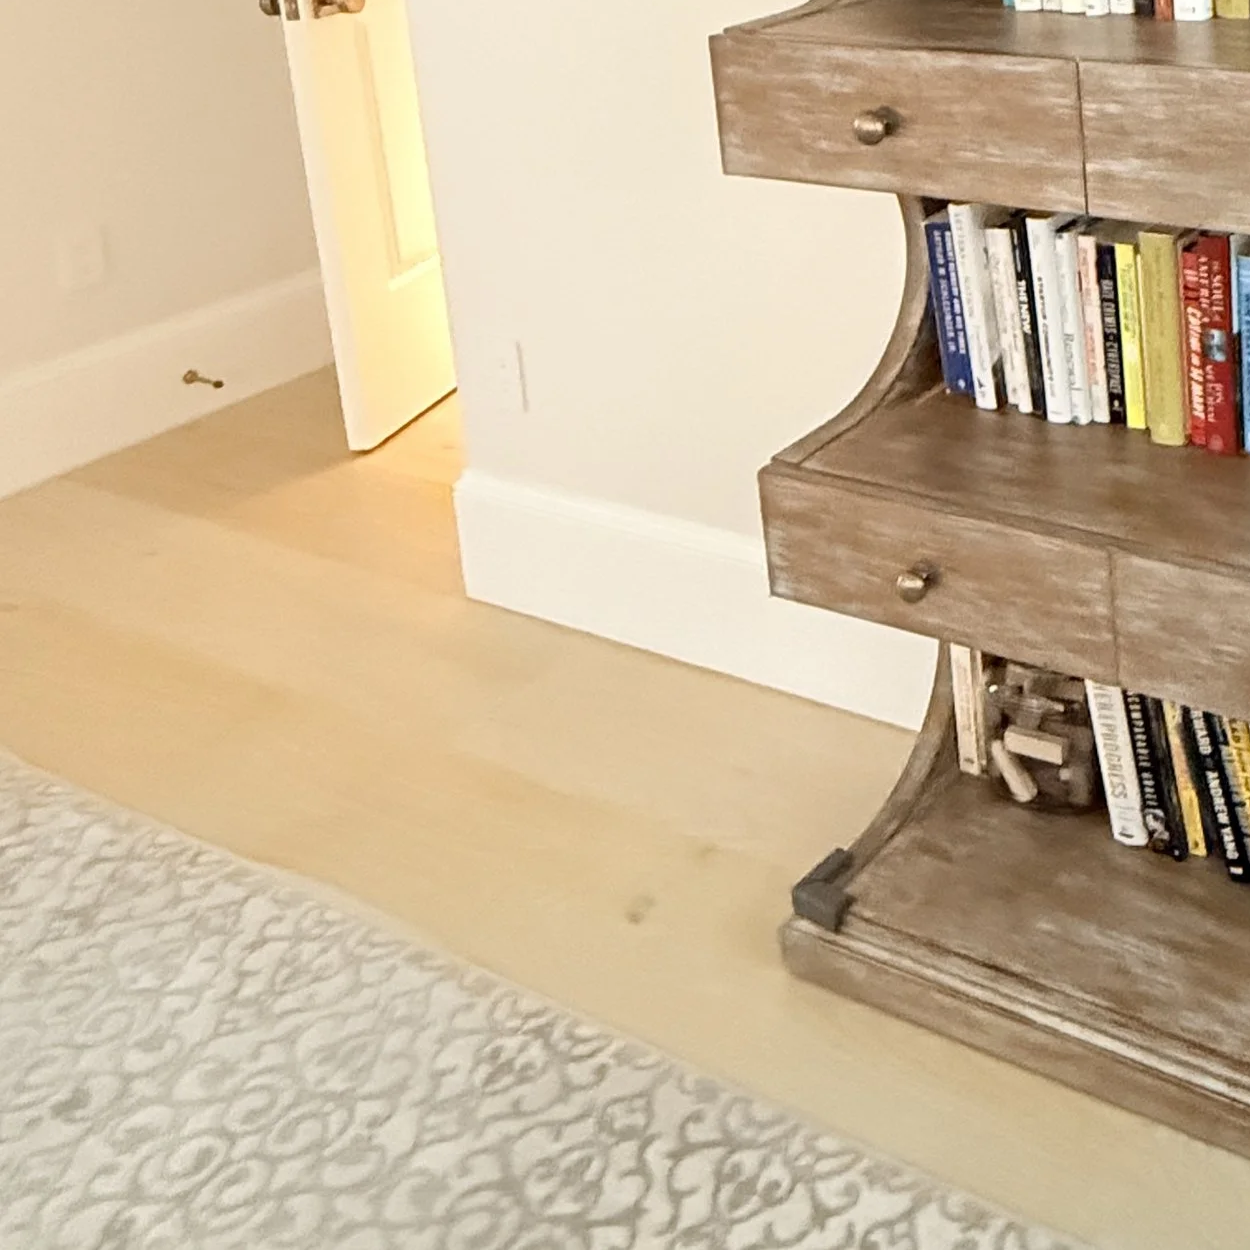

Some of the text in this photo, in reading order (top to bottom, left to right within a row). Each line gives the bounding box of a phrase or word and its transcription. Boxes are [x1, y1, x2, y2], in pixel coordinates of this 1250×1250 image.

[1016, 279, 1032, 335] THE NEW
[1036, 276, 1047, 321] STARTUP
[1190, 710, 1212, 755] RWARD
[1205, 771, 1231, 825] ANDREW
[1220, 827, 1239, 860] YANG
